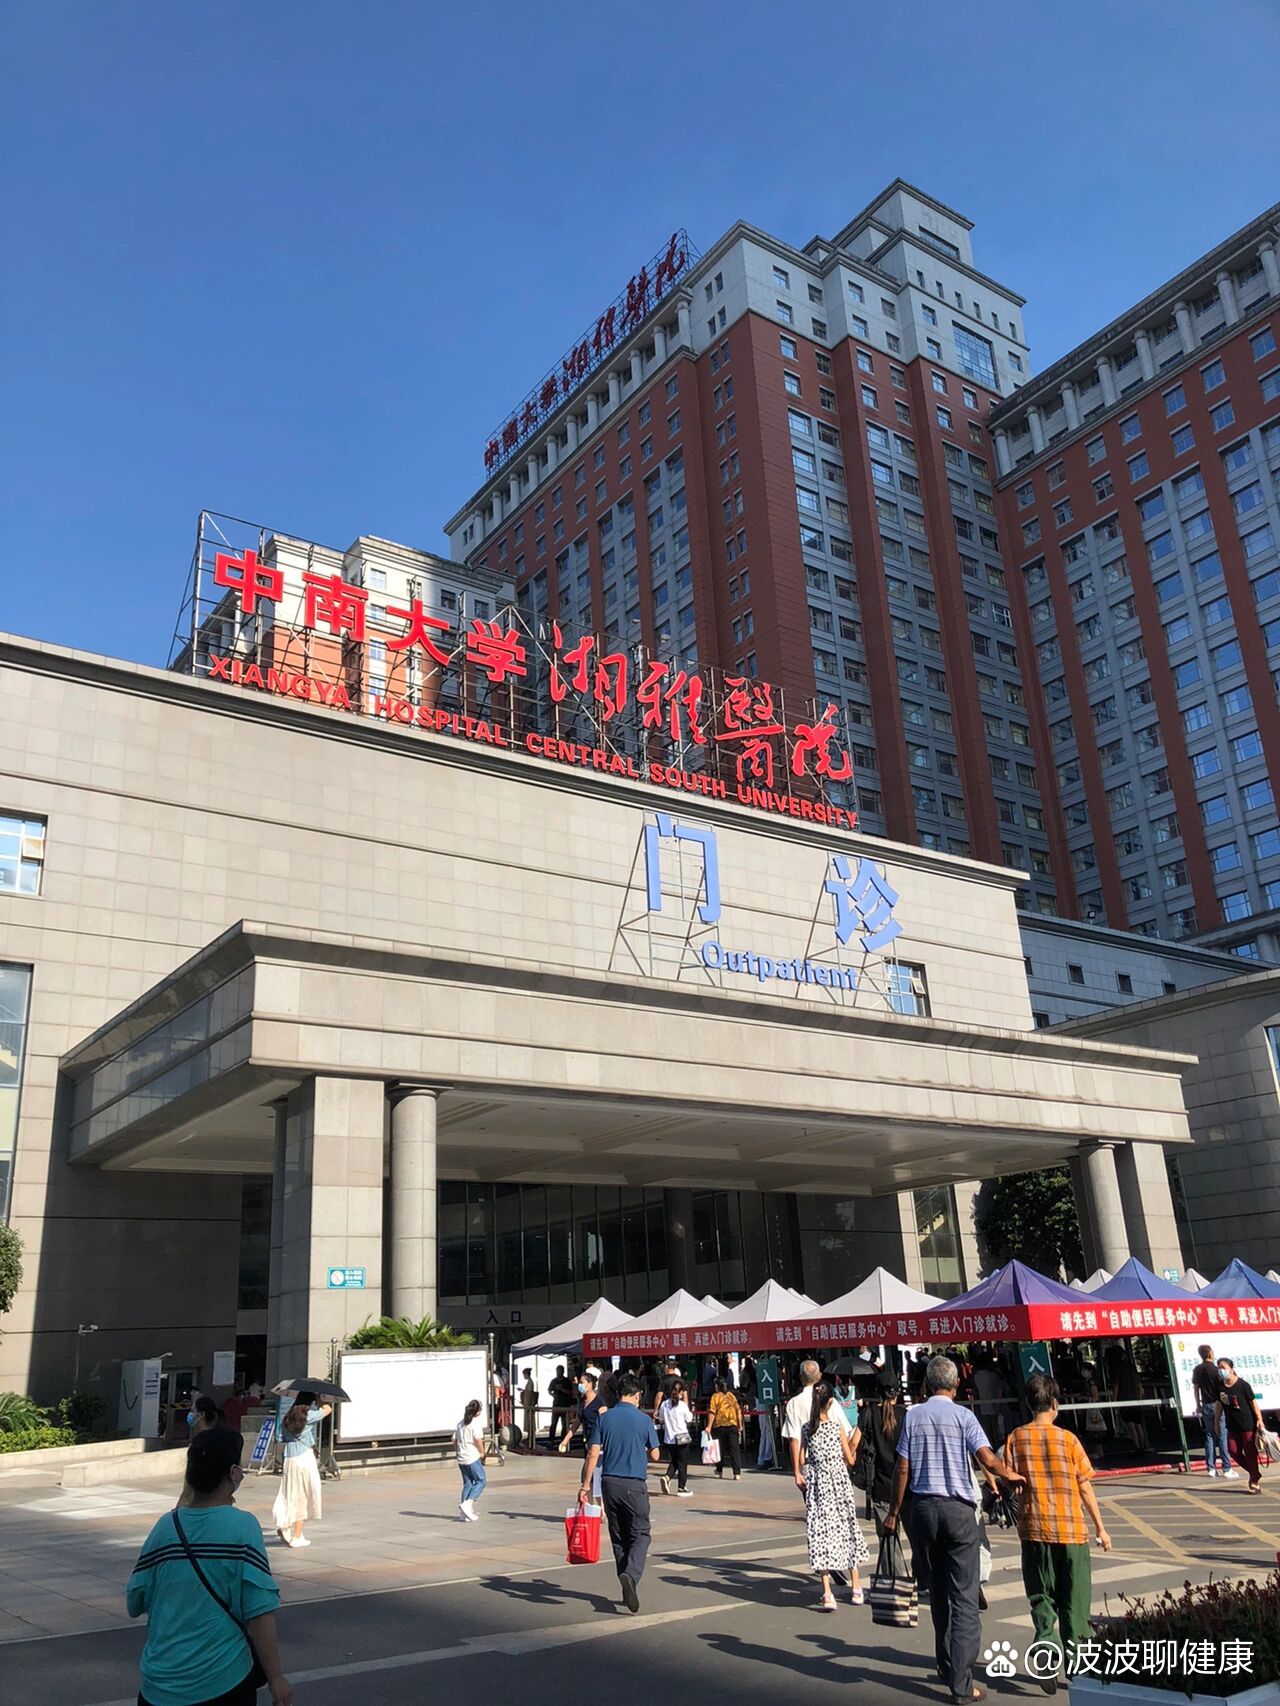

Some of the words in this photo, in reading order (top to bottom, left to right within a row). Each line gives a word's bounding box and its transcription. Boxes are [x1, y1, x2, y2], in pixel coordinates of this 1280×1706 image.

[208, 653, 351, 708] XIANGYA
[373, 694, 508, 746] HOSPITAL
[526, 732, 640, 779] CENTRAL
[649, 763, 727, 799] SOUTH
[737, 783, 860, 829] UNIVERSITY
[644, 813, 904, 953] 门诊
[701, 939, 859, 991] Outpatient
[486, 1309, 522, 1325] 入口
[761, 1369, 774, 1400] 入口
